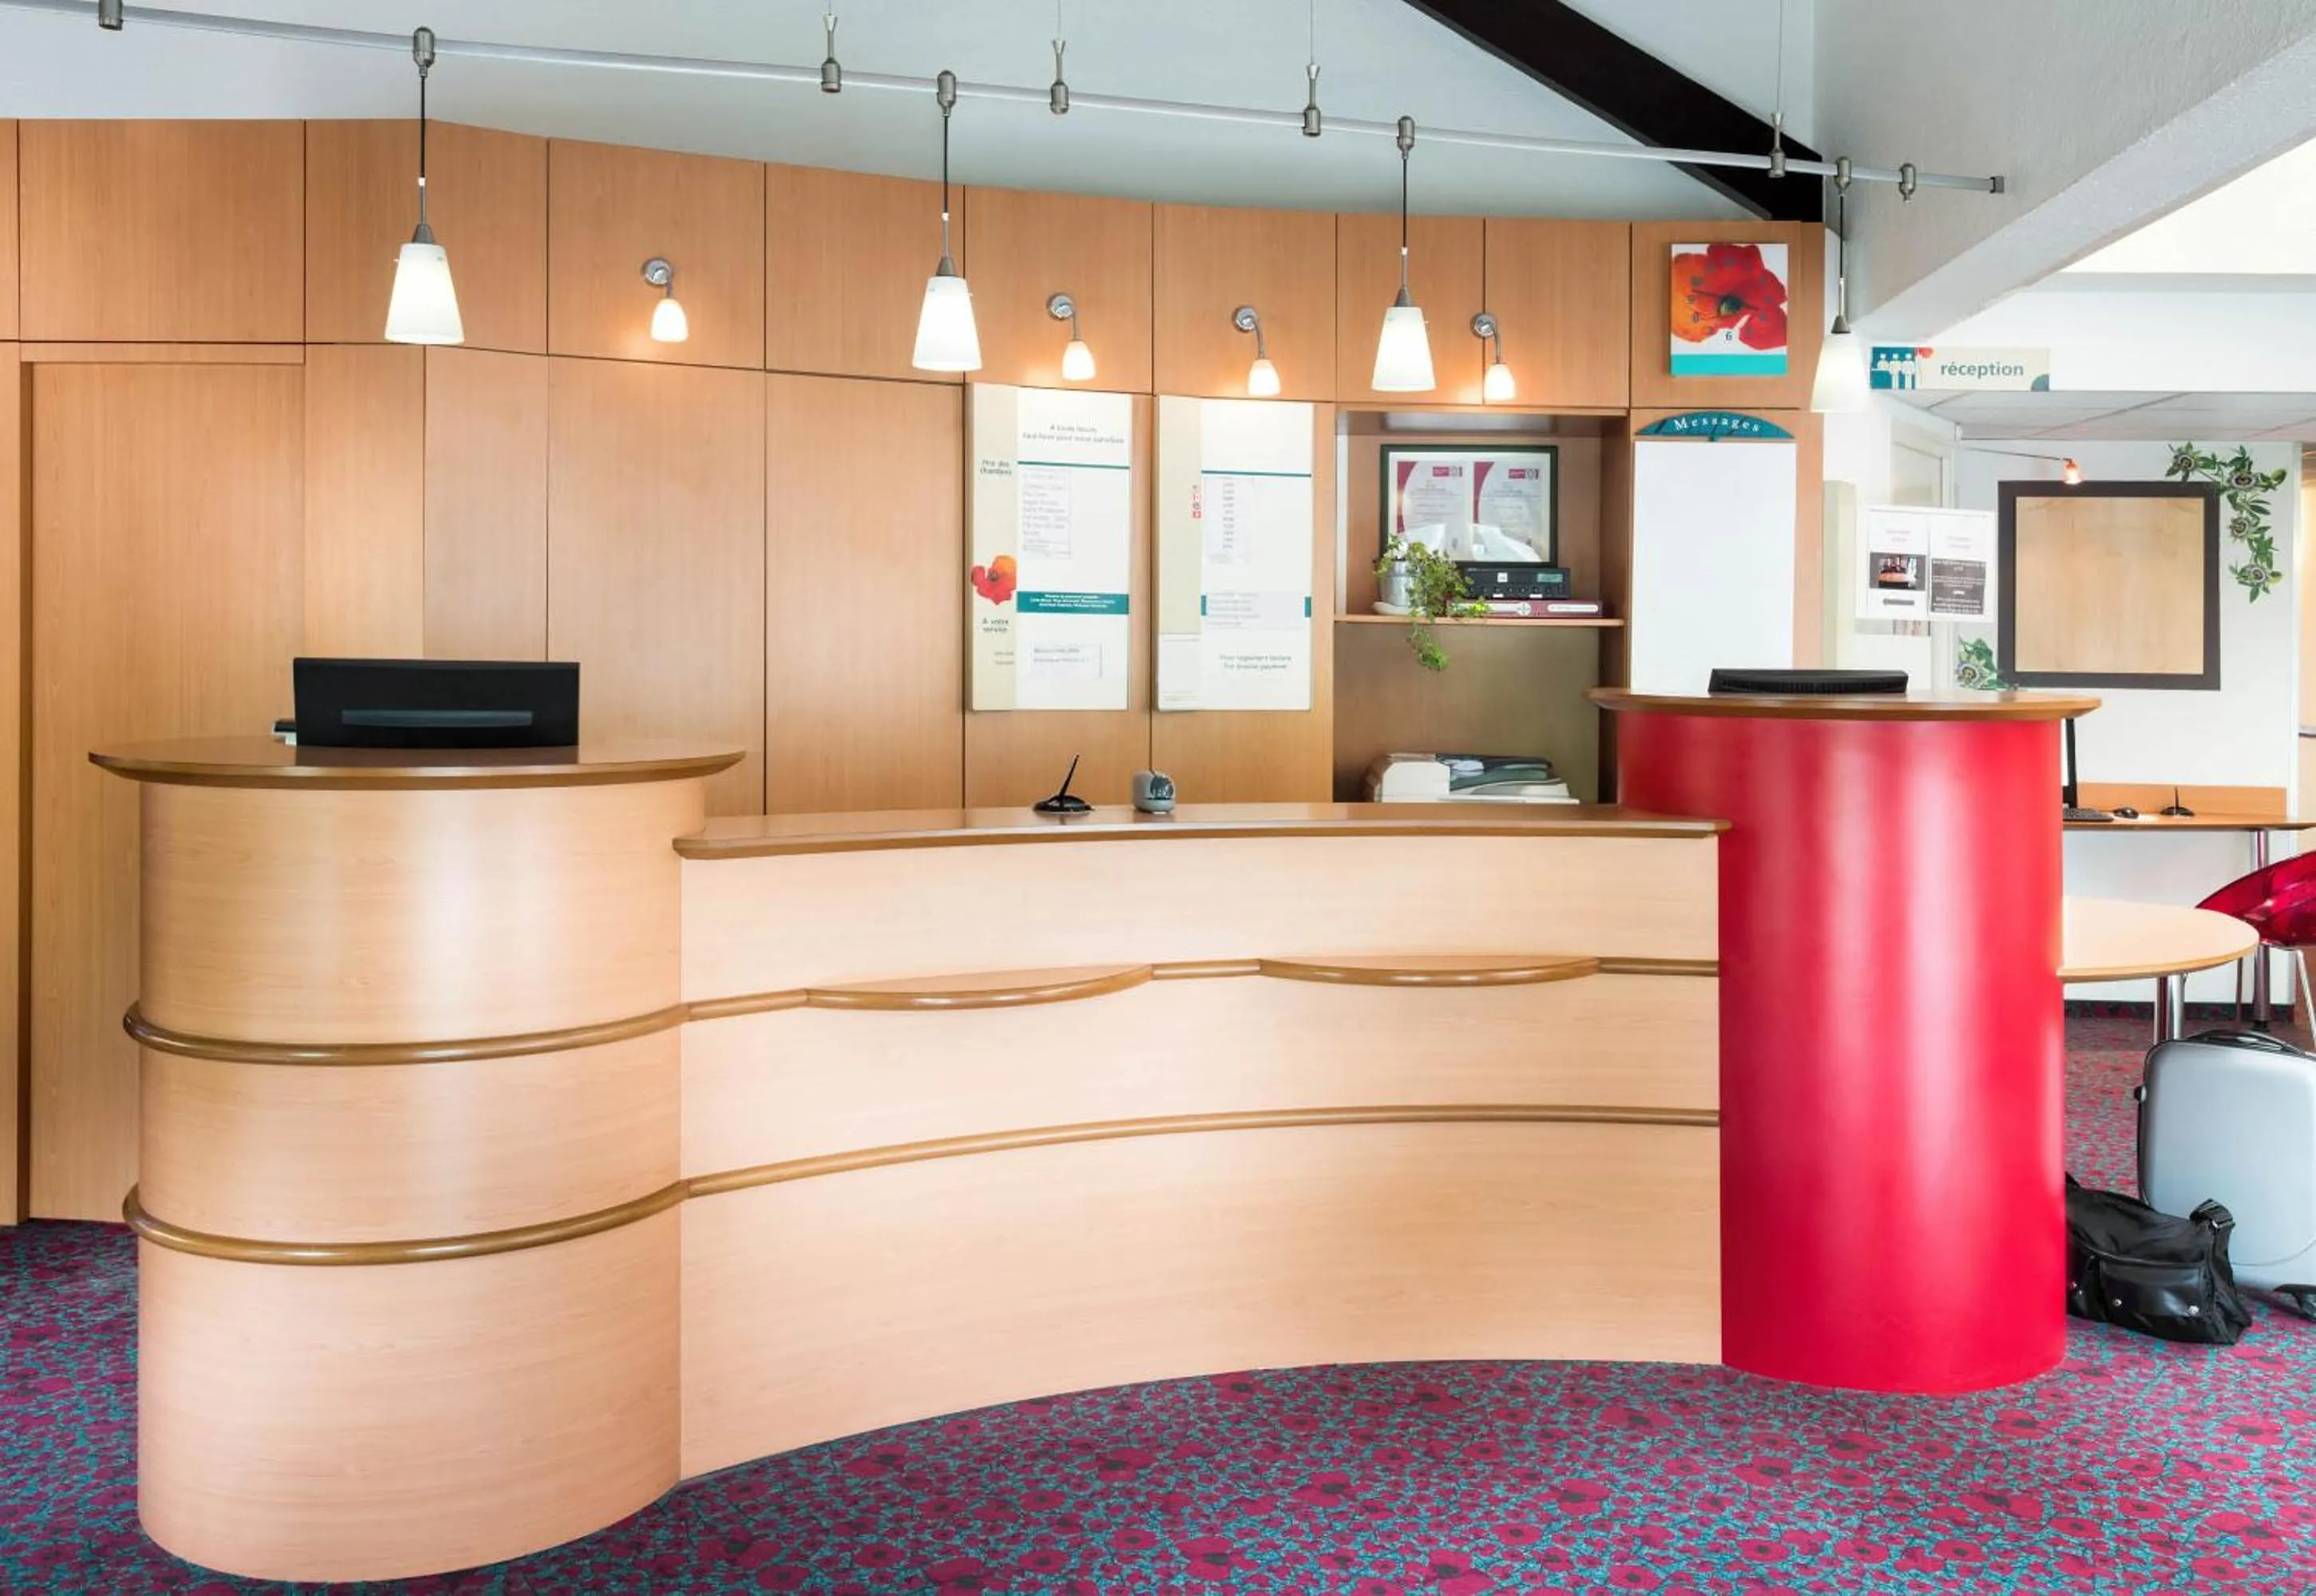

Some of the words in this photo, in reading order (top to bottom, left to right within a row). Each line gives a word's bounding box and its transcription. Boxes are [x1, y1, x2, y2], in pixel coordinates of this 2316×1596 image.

[1725, 331, 1733, 341] 6
[1940, 361, 2025, 379] réception
[1673, 417, 1760, 432] Messages
